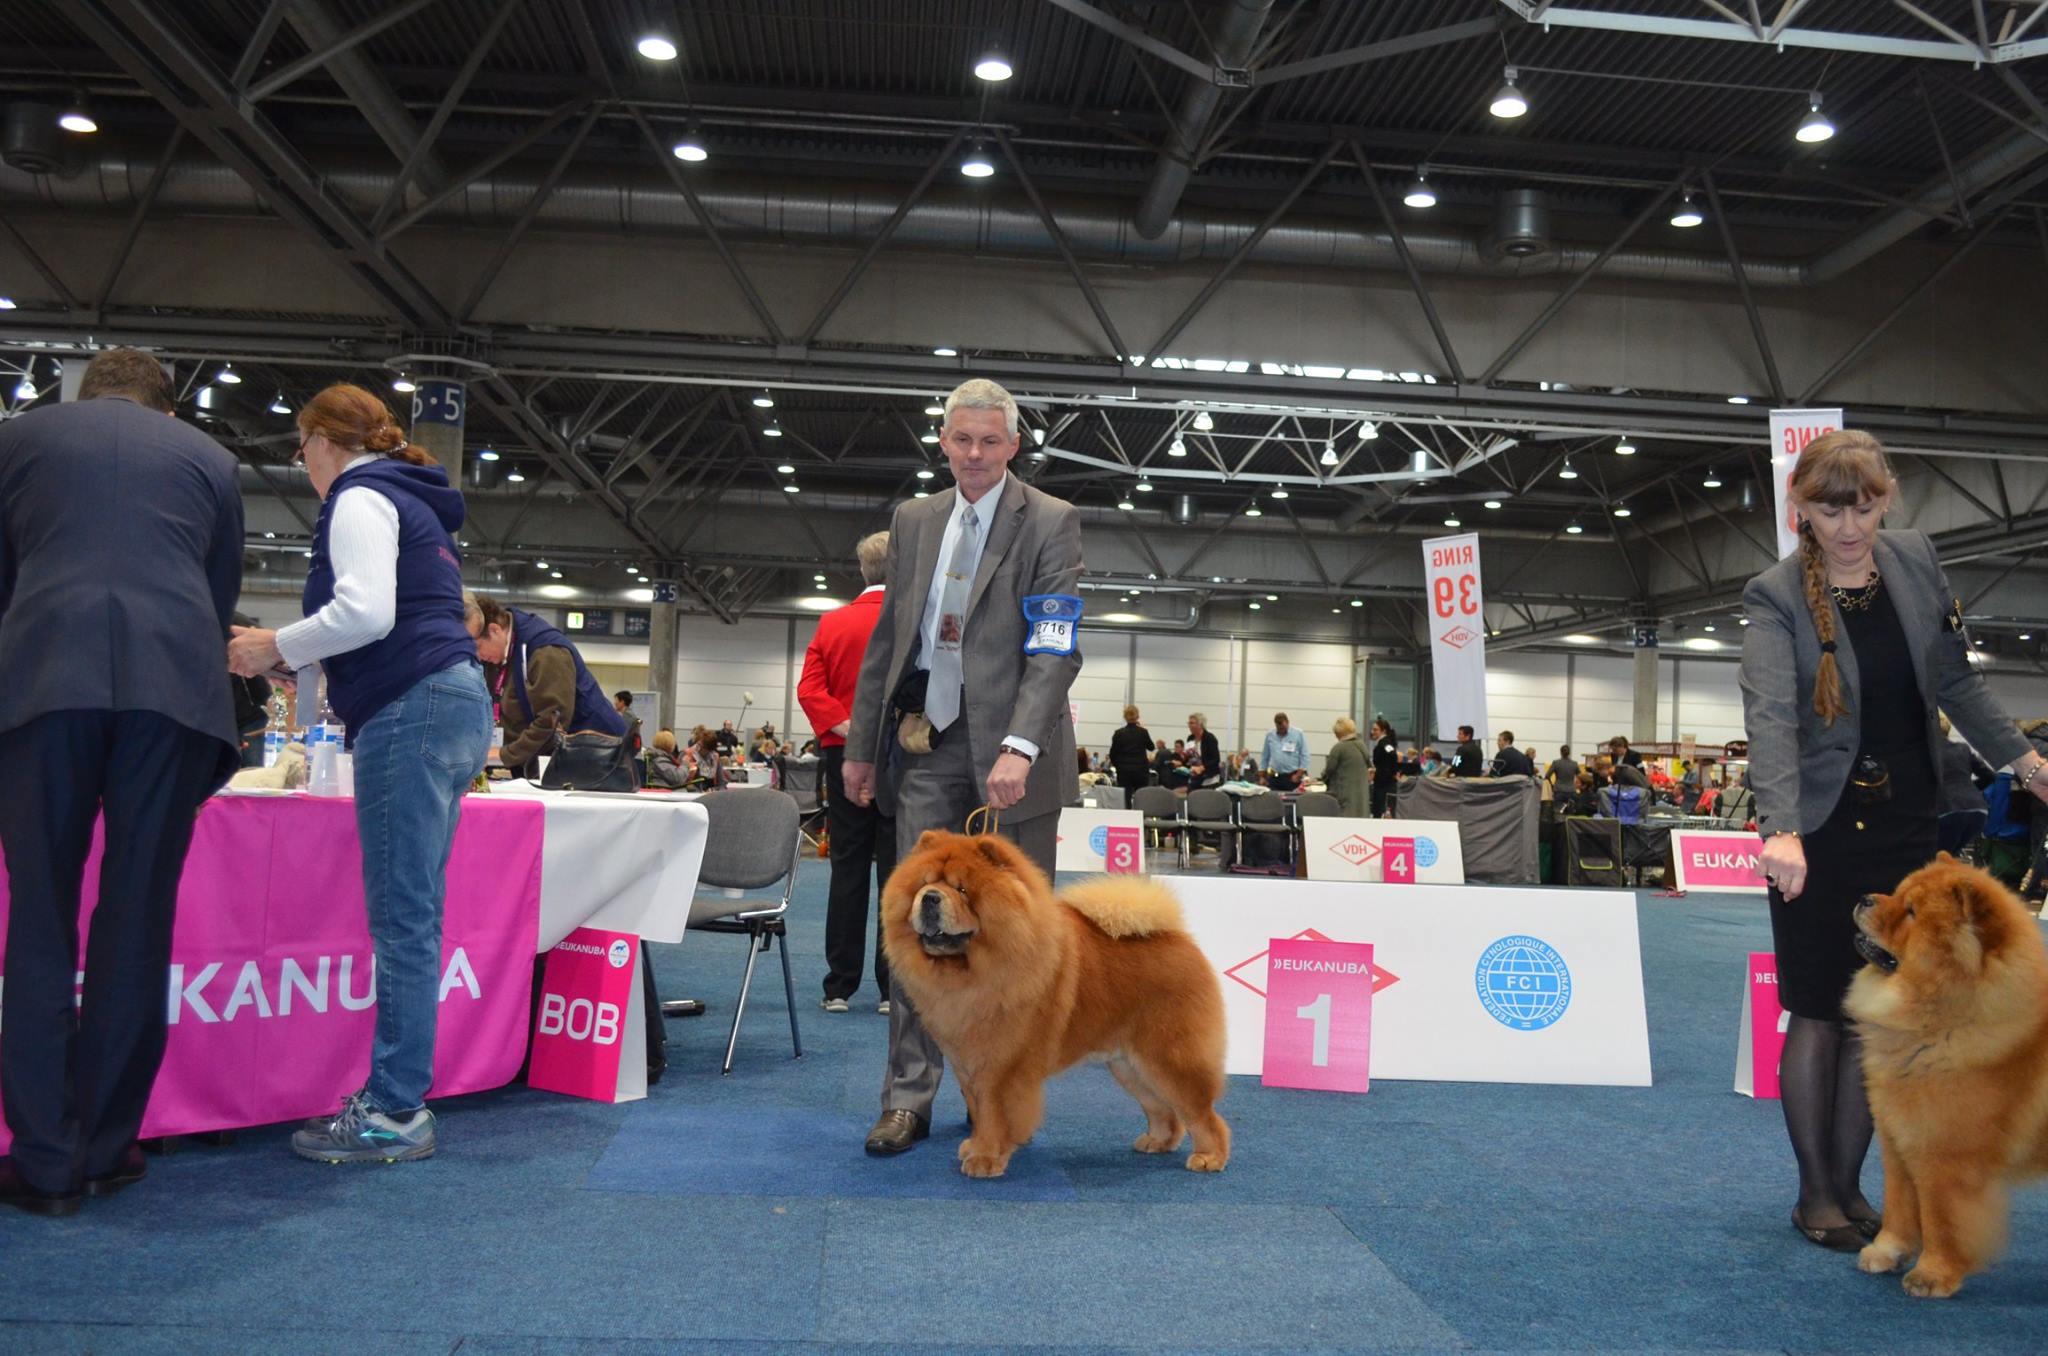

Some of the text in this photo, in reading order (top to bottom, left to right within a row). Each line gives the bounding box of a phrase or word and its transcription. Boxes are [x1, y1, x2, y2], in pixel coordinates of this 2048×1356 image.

[1036, 622, 1065, 635] 2716
[1114, 843, 1133, 867] 3
[1343, 844, 1368, 855] VDH
[1692, 852, 1760, 870] EUKAN
[1390, 852, 1408, 877] 4
[75, 946, 482, 1026] KANUA
[1481, 937, 1546, 967] CYNOLOGIQUE
[1541, 949, 1570, 1026] INTERNATIONALE
[1506, 975, 1541, 990] FCI
[540, 992, 620, 1046] BOB
[1296, 993, 1332, 1067] 1
